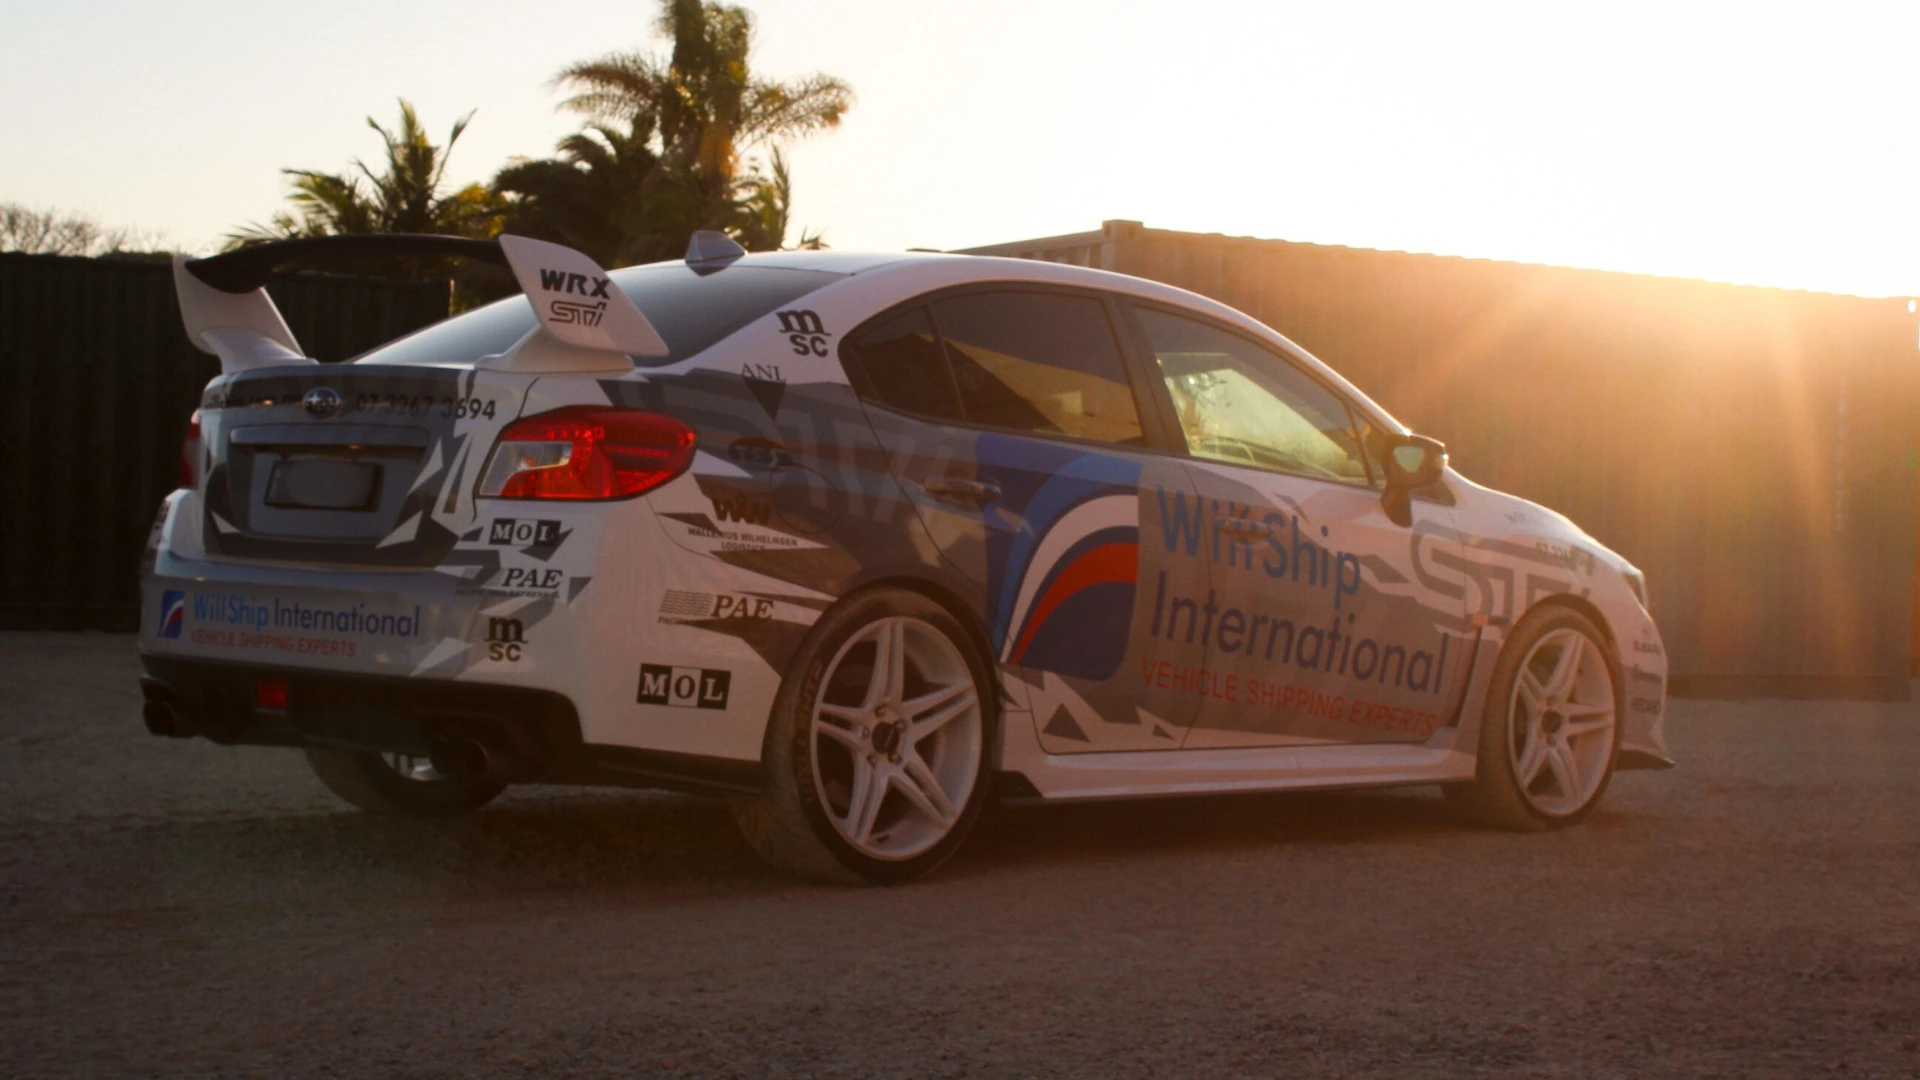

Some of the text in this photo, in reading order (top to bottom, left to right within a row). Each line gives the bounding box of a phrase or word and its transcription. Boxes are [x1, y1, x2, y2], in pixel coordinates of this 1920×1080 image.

[540, 268, 611, 300] WRX
[441, 397, 497, 420] 3694
[740, 532, 798, 547] WILHELMSEN
[501, 567, 563, 589] PAE
[274, 598, 421, 637] International
[711, 593, 775, 620] PAE
[190, 628, 356, 658] VEHICLE SHIPPING EXPERTS
[1151, 570, 1449, 695] International
[640, 671, 725, 703] MOL
[1141, 657, 1439, 738] VEHICLE SHIPPING EXPERTS
